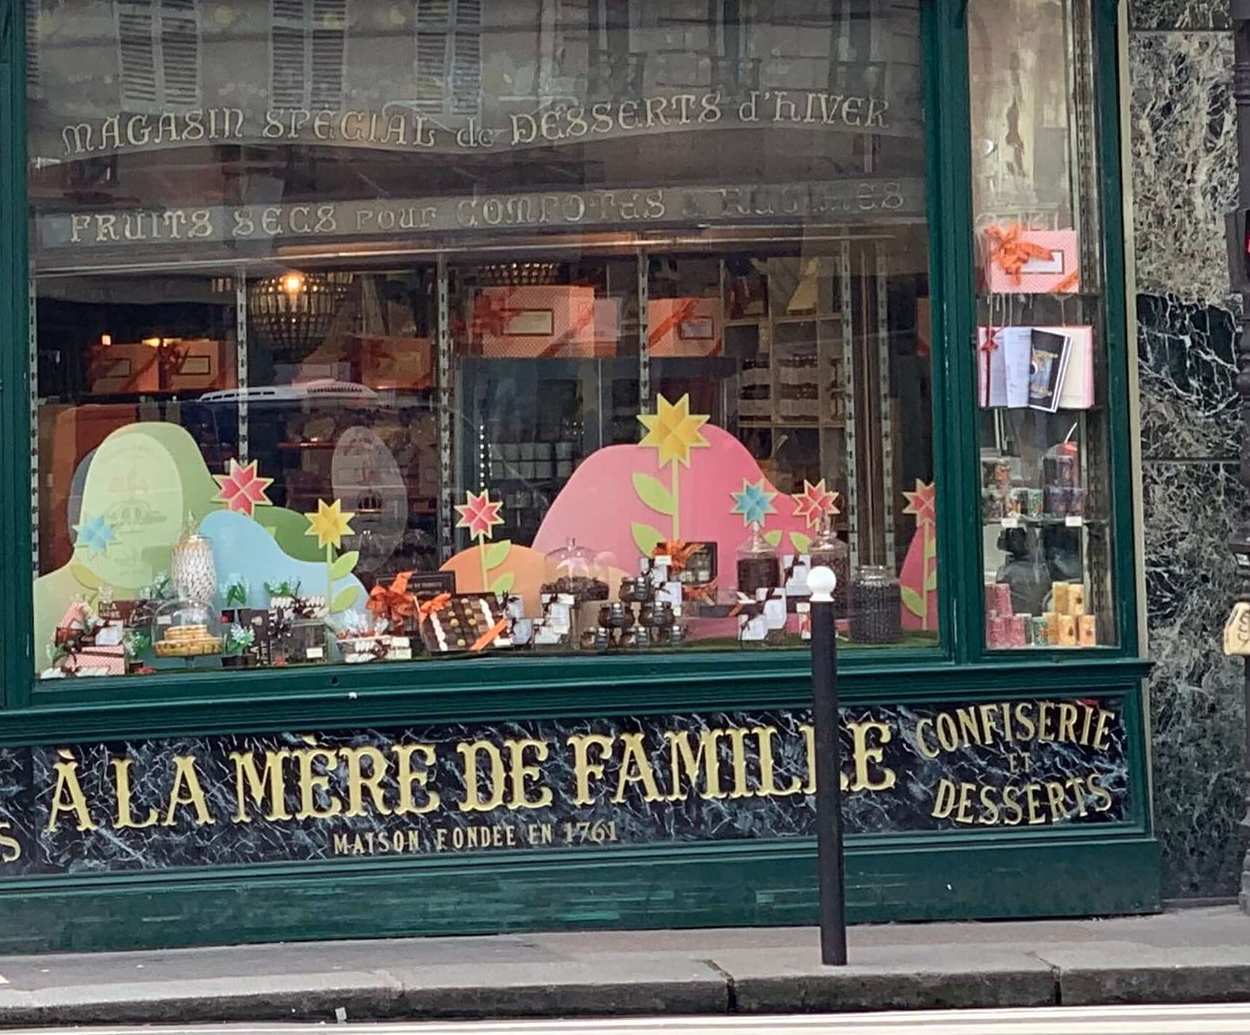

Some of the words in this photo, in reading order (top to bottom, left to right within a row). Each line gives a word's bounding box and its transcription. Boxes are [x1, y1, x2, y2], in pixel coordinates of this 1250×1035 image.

[61, 107, 244, 157] MAGASIN
[510, 91, 722, 146] DESSERTS
[70, 207, 214, 244] FRUITS
[916, 698, 1116, 760] CONFISERIE
[48, 748, 98, 833] À
[111, 755, 216, 830] LA
[230, 735, 441, 824] MÈRE
[457, 737, 554, 813] DE
[1008, 751, 1032, 773] ET
[931, 773, 1113, 826] DESSERTS
[333, 828, 420, 856] MAISON
[529, 823, 553, 845] EN
